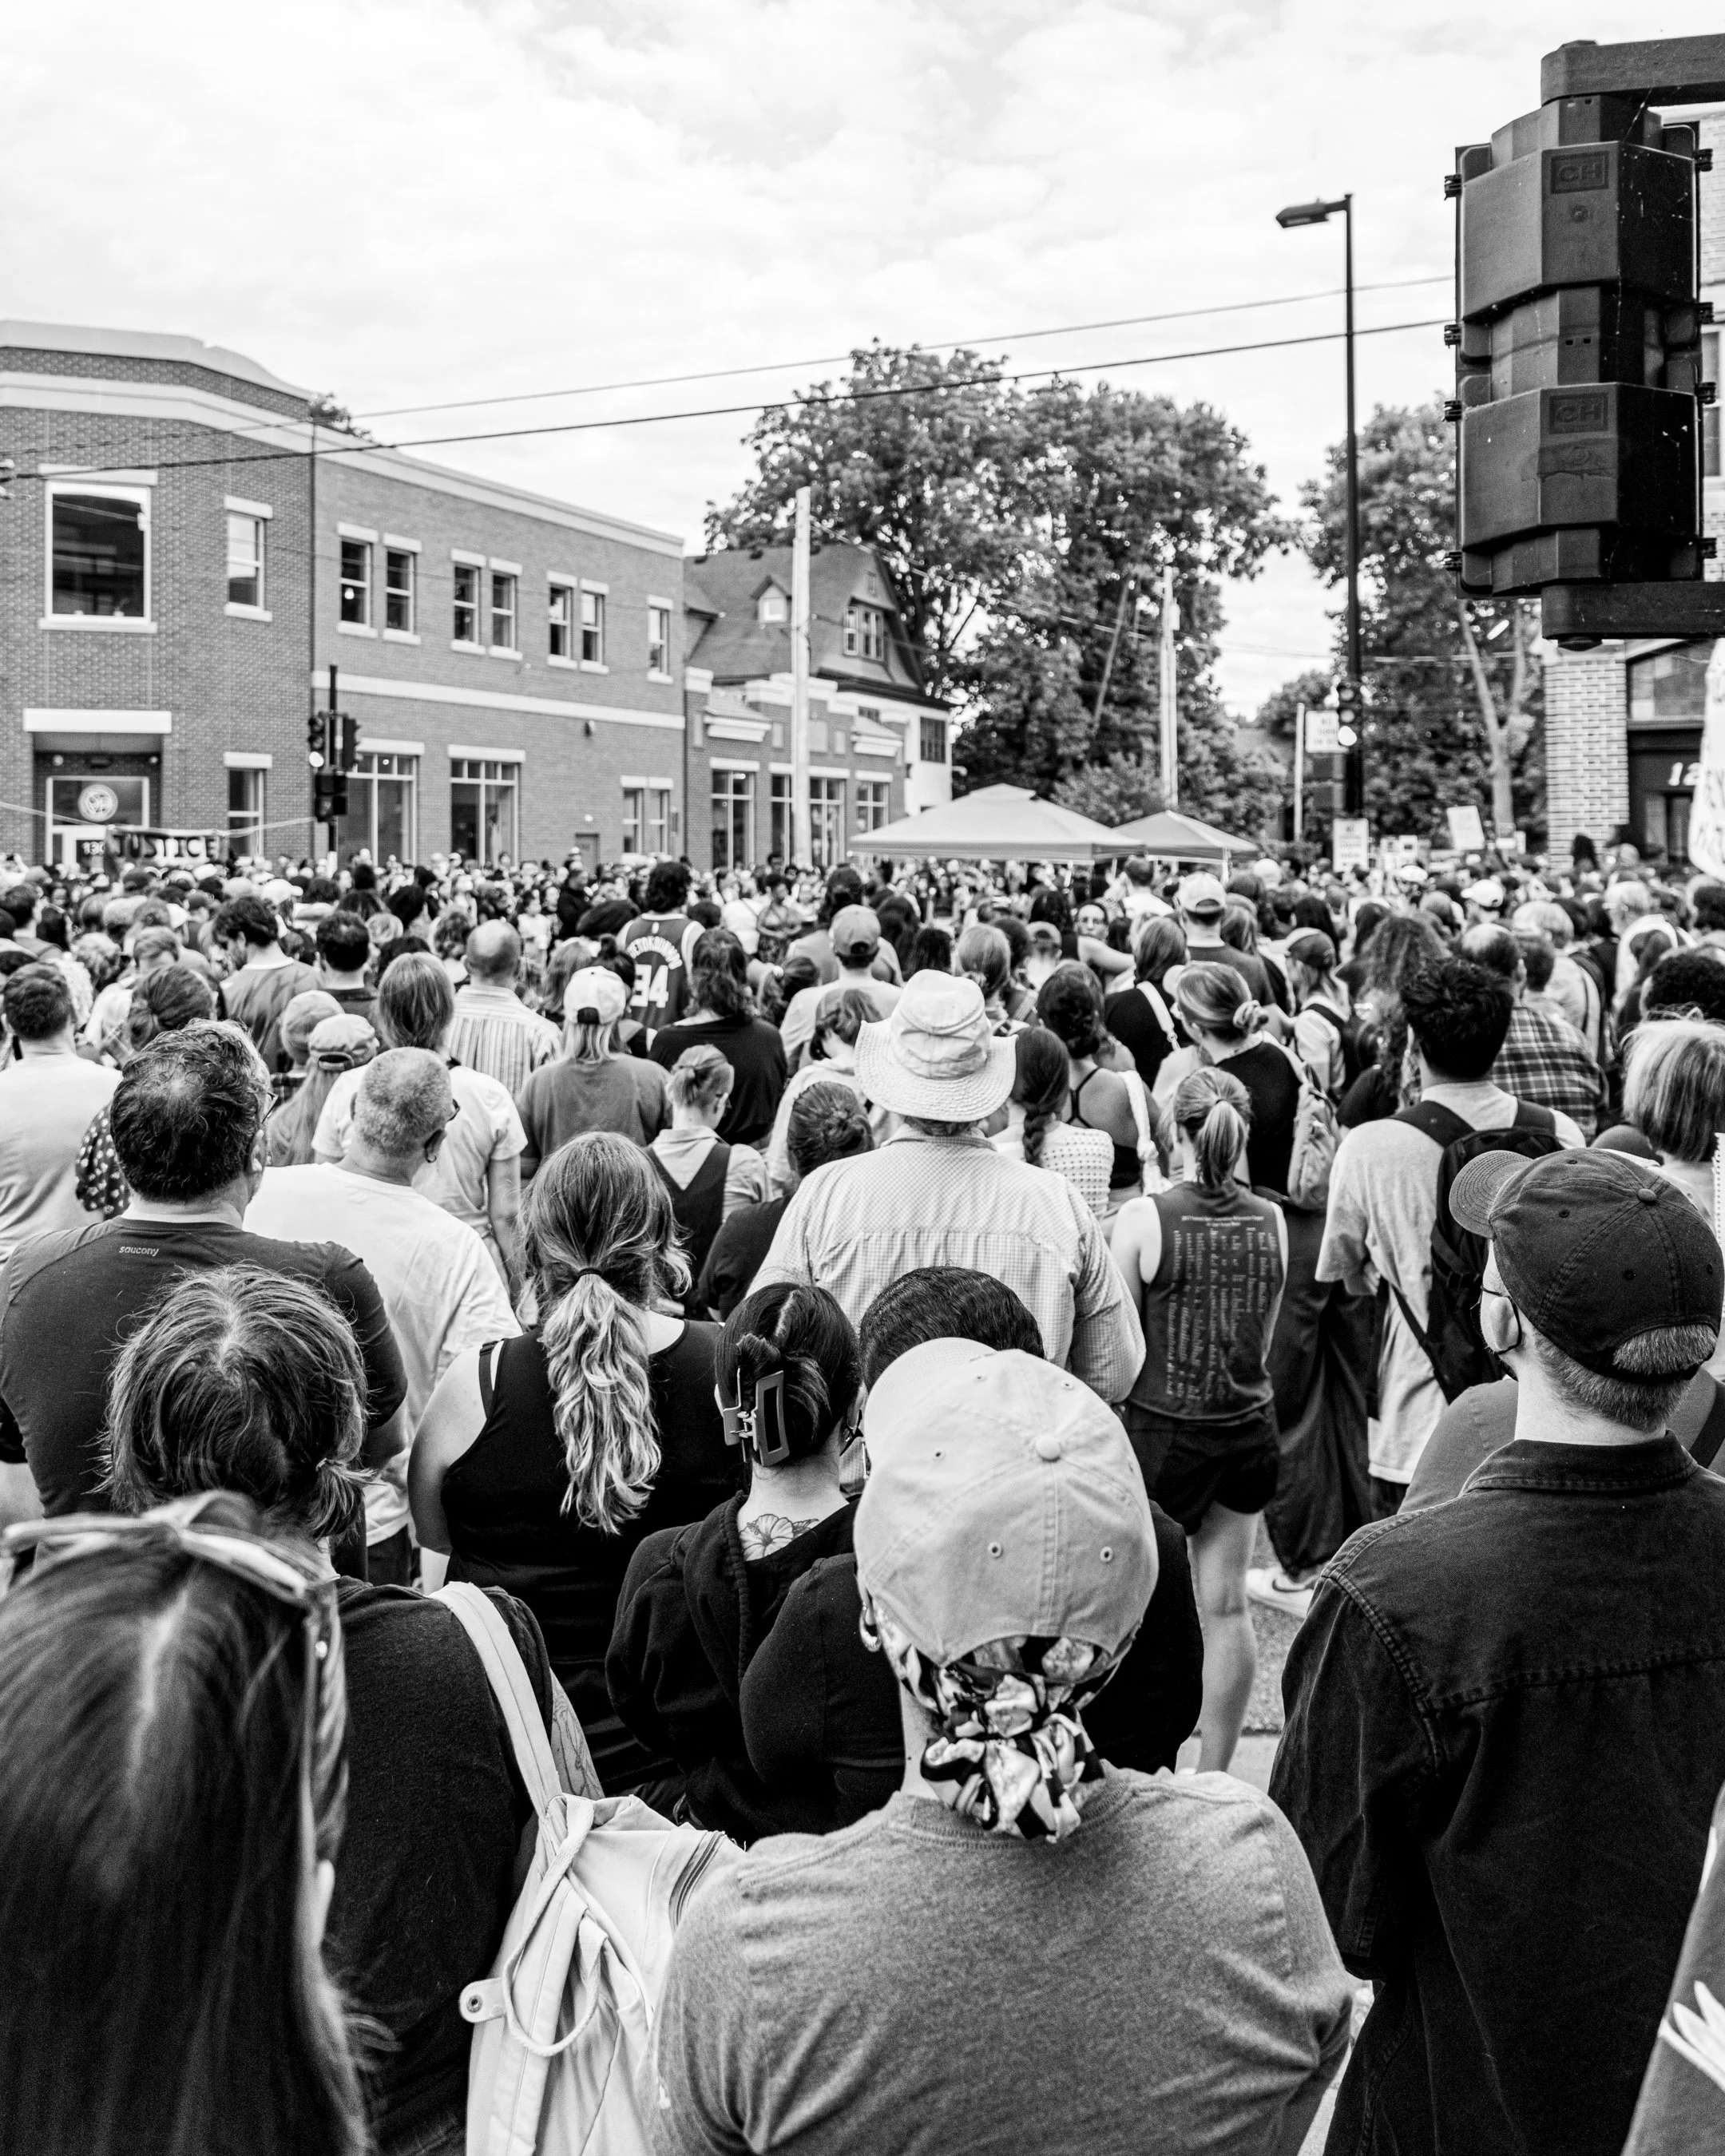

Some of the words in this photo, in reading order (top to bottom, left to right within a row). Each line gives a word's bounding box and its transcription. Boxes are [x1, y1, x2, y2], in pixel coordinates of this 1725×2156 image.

[113, 834, 217, 858] JUSTICE
[629, 964, 669, 1008] 34
[118, 1246, 159, 1257] saucony
